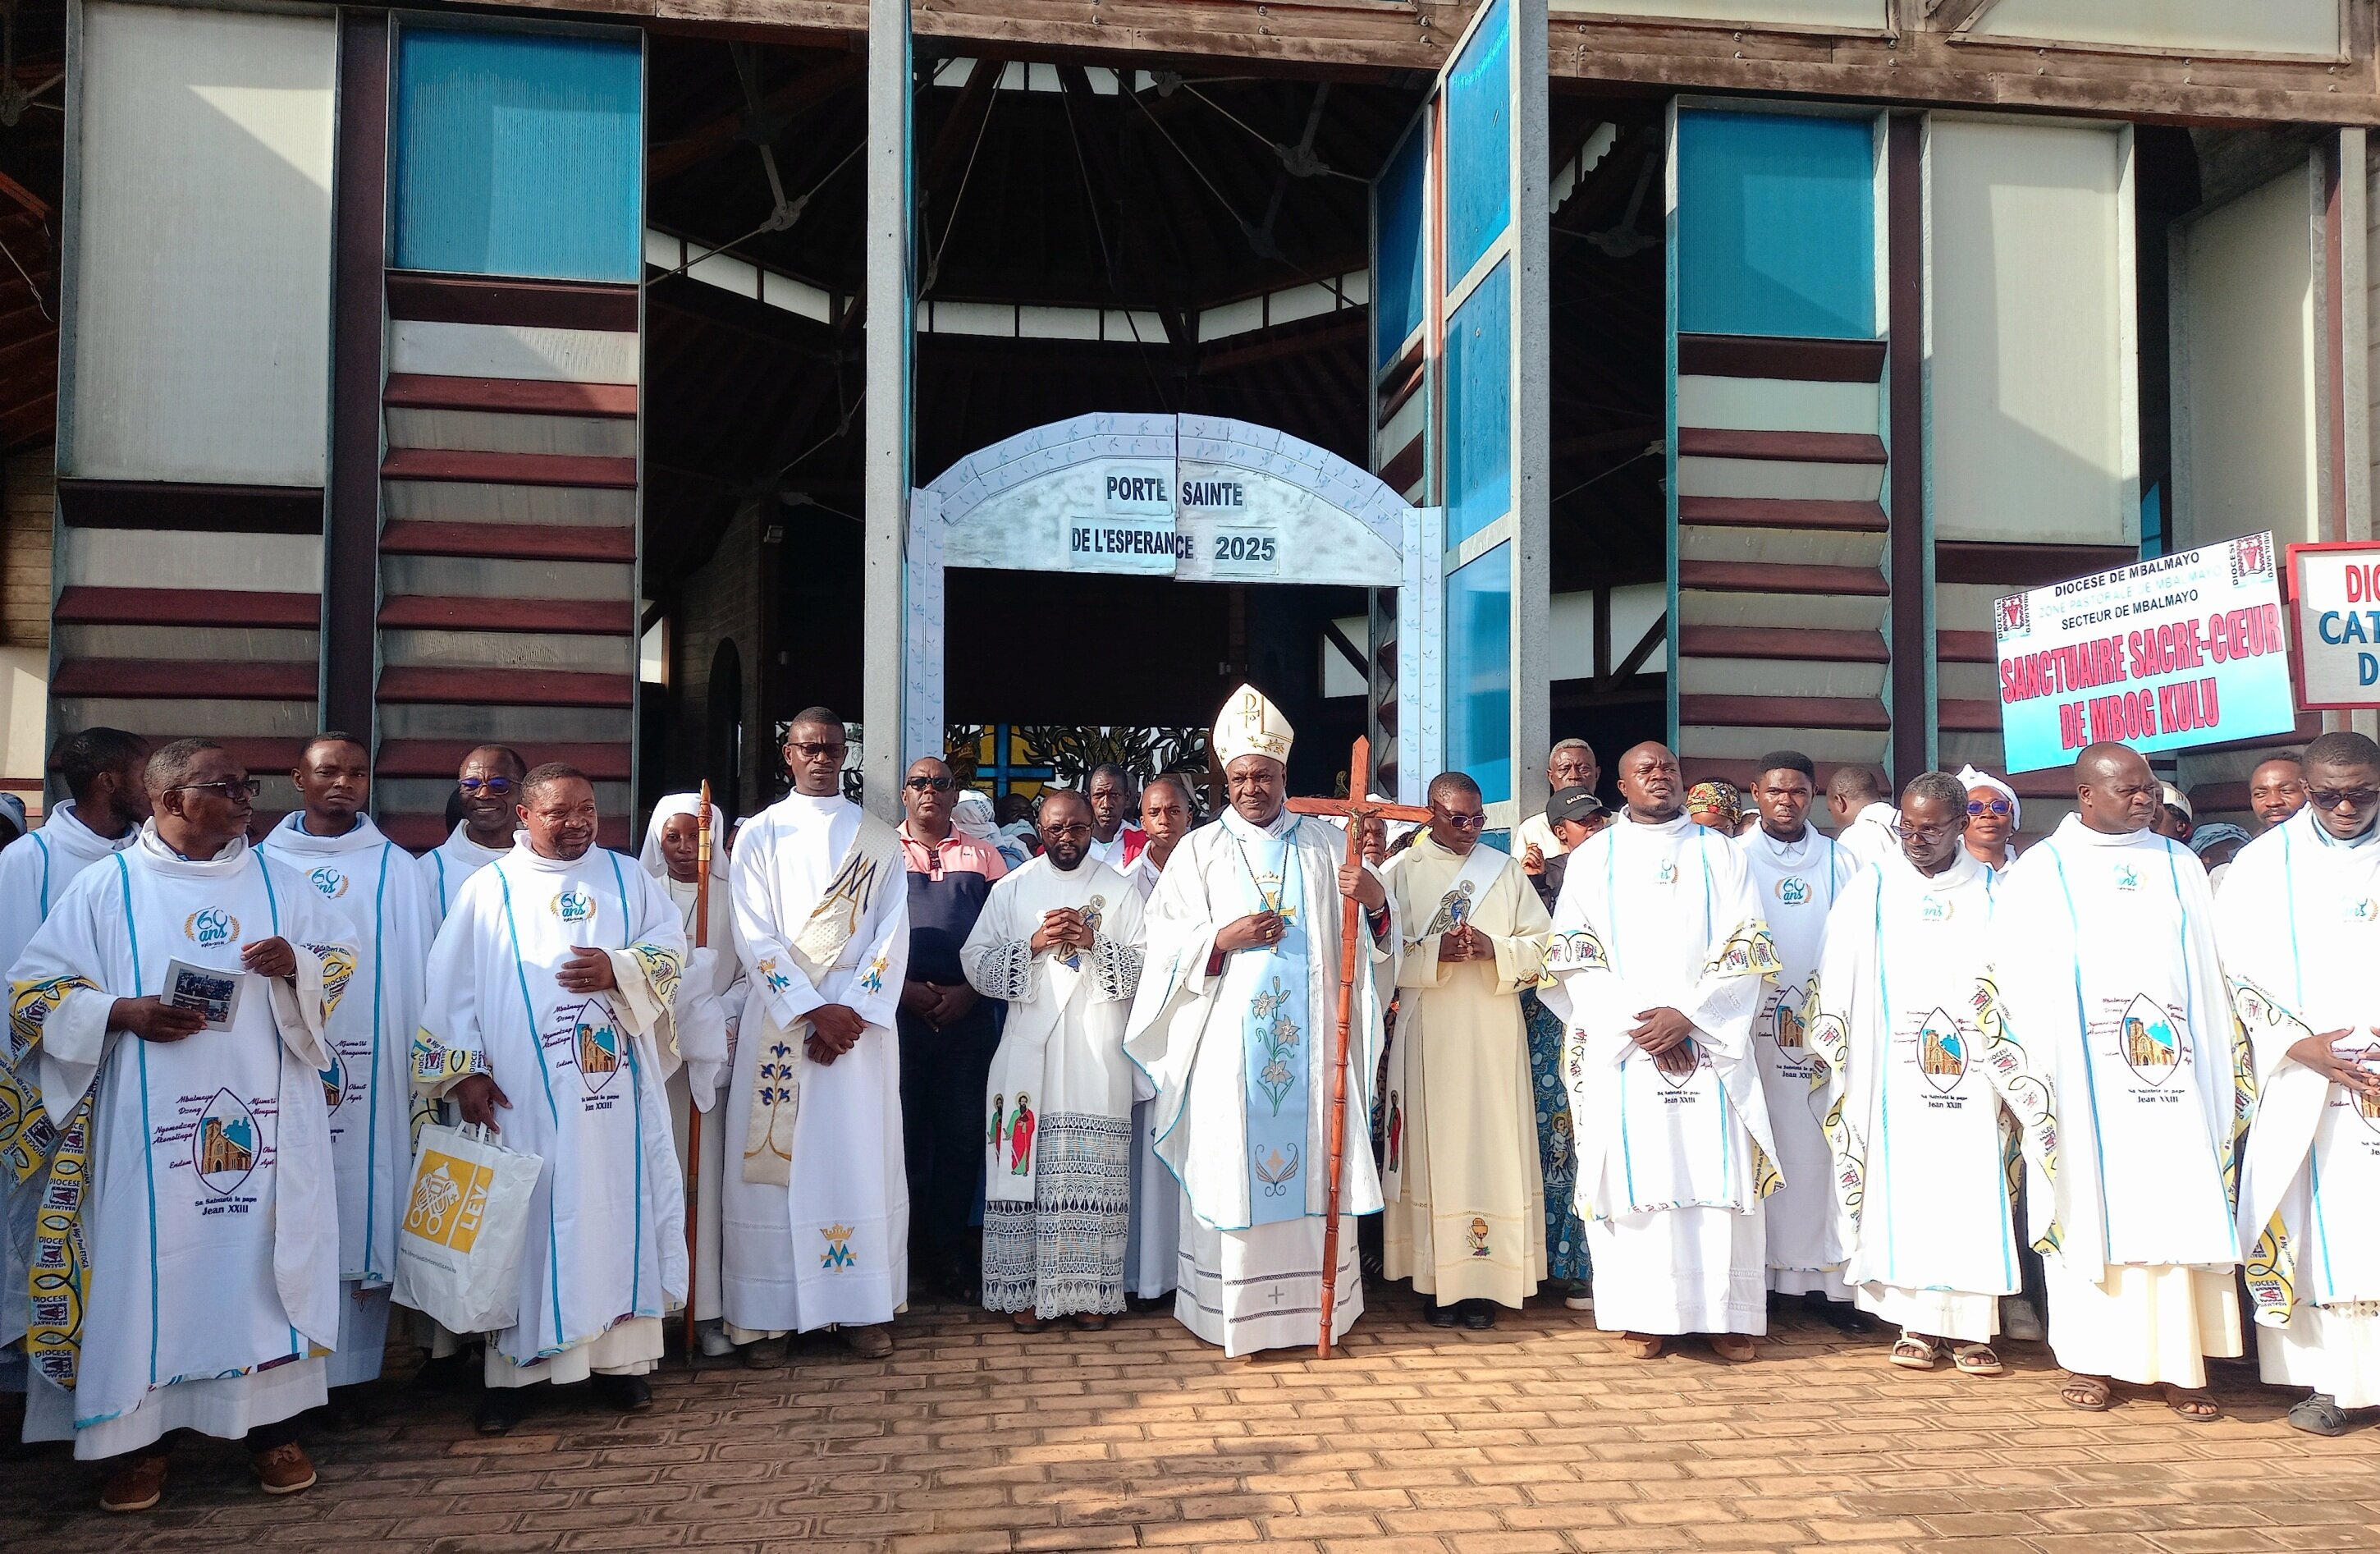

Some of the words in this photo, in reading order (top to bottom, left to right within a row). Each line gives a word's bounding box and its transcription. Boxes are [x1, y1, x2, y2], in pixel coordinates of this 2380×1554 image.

[1106, 477, 1168, 502] PORTE
[1183, 482, 1243, 507] SAINTE
[1072, 528, 1090, 552] DE
[1095, 528, 1194, 559] L'ESPERANCE
[1215, 536, 1275, 561] 2025
[2228, 543, 2240, 585] DIOCESE
[2263, 533, 2274, 578] MBALMAYO
[2055, 575, 2105, 598] DIOCESE
[2109, 570, 2126, 584] DE
[2129, 552, 2200, 580] MBALMAYO
[2039, 603, 2066, 618] ZONE
[2070, 585, 2132, 610] PASTORALE
[2062, 609, 2112, 630] SECTEUR
[2115, 604, 2130, 618] DE
[2133, 589, 2199, 614] MBALMAYO
[2023, 592, 2031, 633] MBALMAYO
[2001, 635, 2127, 704] SANCTUAIRE
[2059, 701, 2088, 750] DE
[2089, 688, 2156, 745] MBOG
[2158, 676, 2220, 734] KULU
[311, 869, 340, 884] 60
[1783, 878, 1806, 892] 60
[315, 882, 336, 894] ns
[1783, 890, 1804, 901] ans
[561, 892, 587, 907] 60
[197, 909, 228, 930] 60
[561, 905, 586, 918] ans
[199, 924, 228, 942] ans
[176, 1094, 215, 1104] Mbalmayo
[596, 1101, 612, 1110] XXIII
[21, 1130, 47, 1157] DIOCESE
[49, 1178, 81, 1188] DIOCESE
[202, 1207, 225, 1216] Jean
[227, 1204, 249, 1213] XXIII
[460, 1184, 487, 1231] LEV
[76, 1239, 85, 1255] Paul
[80, 1254, 89, 1269] ETOGA
[33, 1295, 69, 1304] DIOCESE
[34, 1349, 72, 1359] DIOCESE
